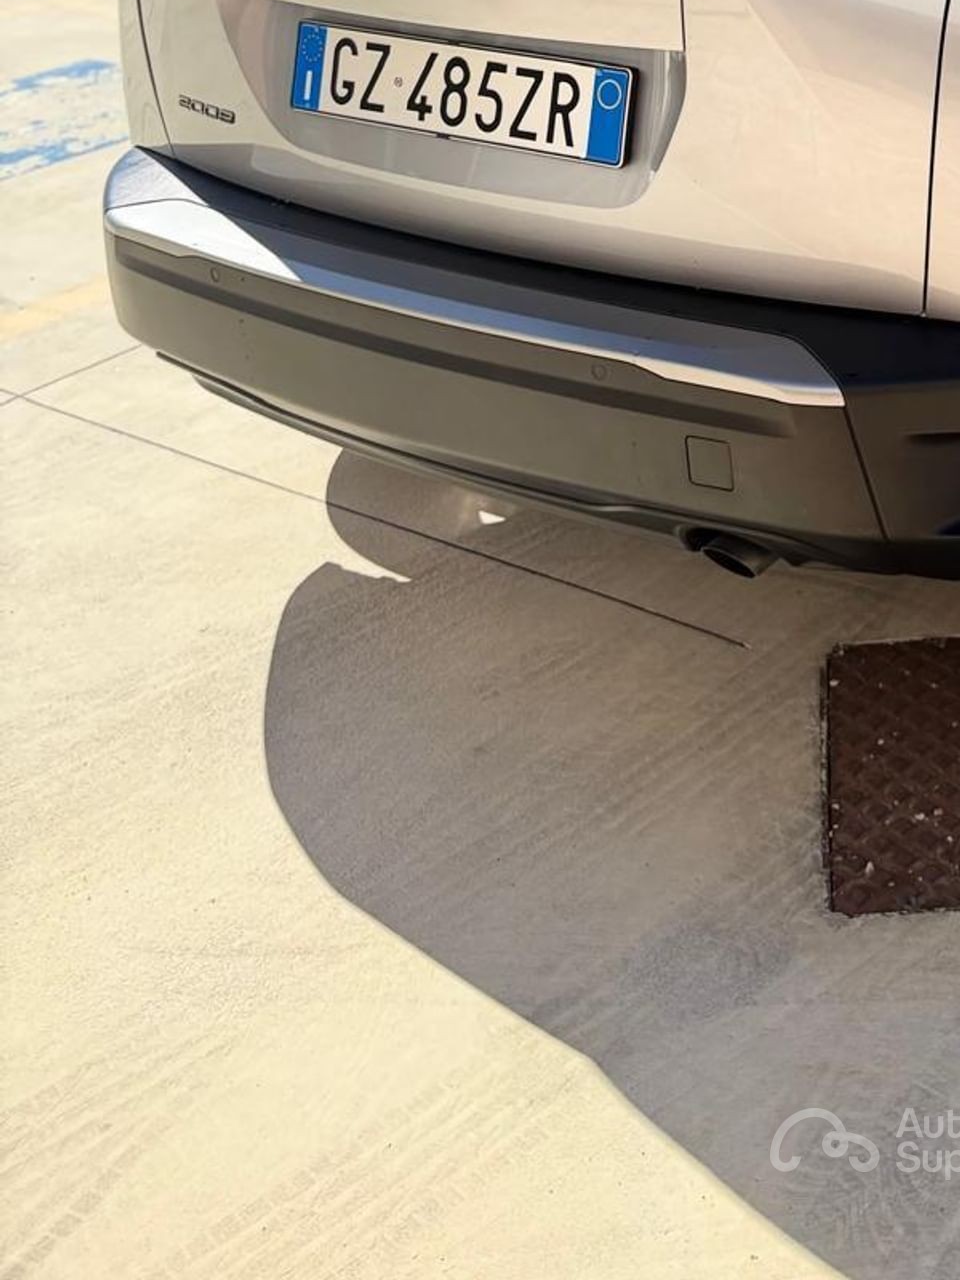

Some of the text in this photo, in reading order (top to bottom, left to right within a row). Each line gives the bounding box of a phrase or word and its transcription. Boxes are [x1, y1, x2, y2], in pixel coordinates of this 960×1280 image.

[178, 94, 236, 125] 2008
[330, 37, 581, 148] GZ 485ZR
